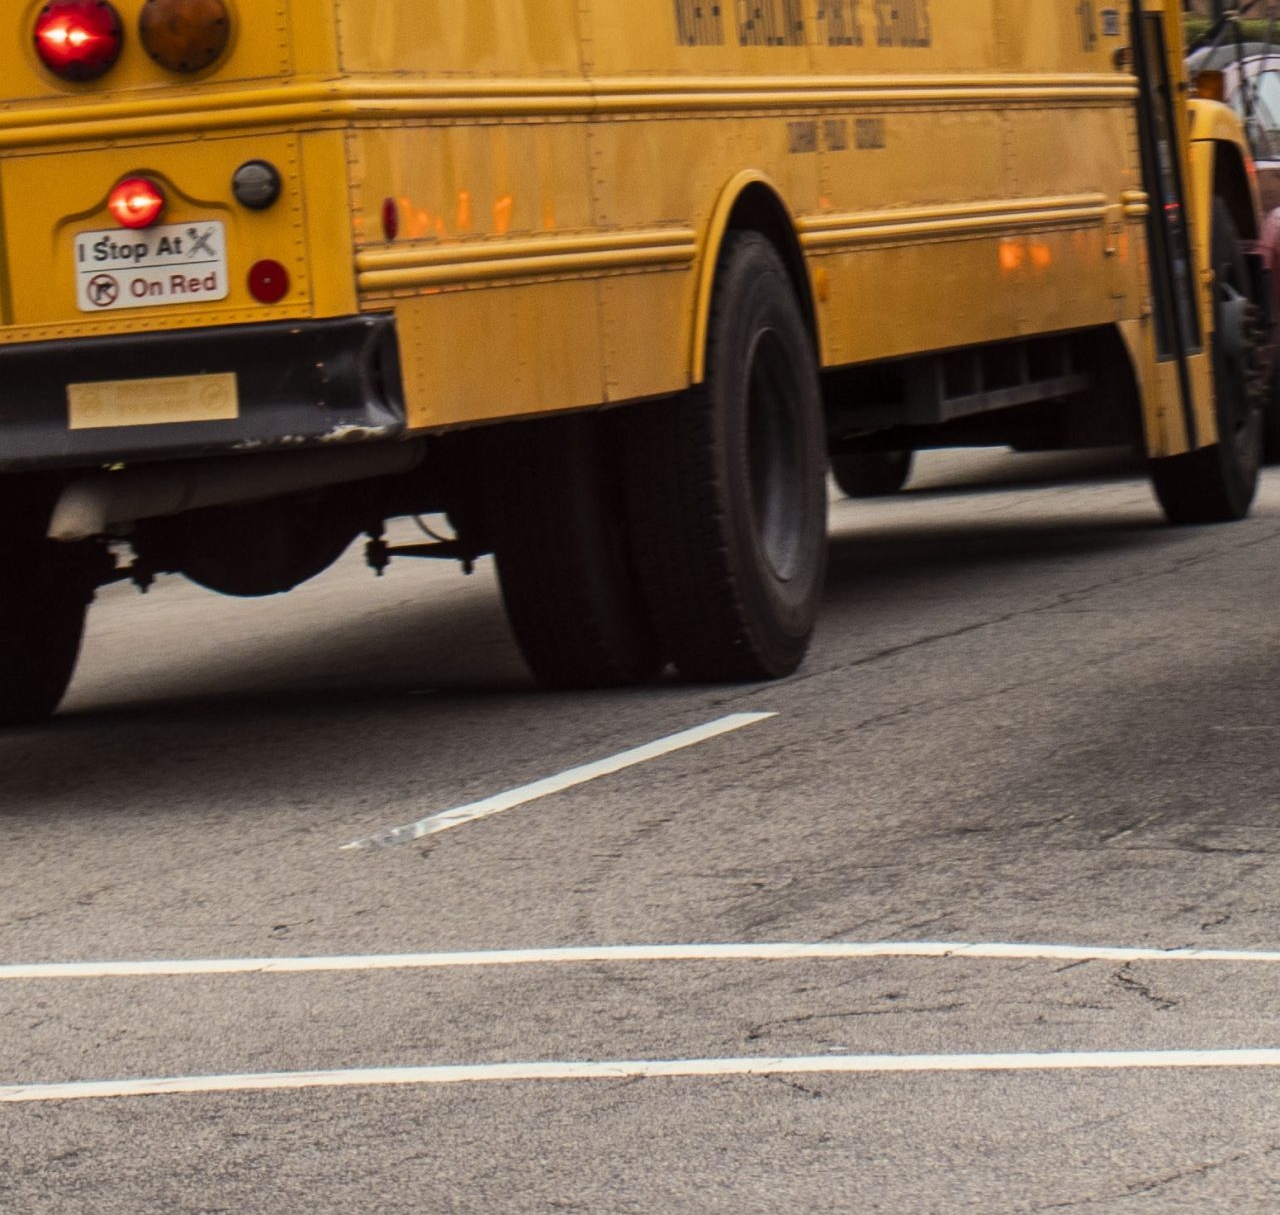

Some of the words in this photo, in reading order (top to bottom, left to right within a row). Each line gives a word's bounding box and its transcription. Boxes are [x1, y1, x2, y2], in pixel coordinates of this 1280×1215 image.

[78, 243, 86, 263] I
[93, 240, 148, 263] Stop
[156, 236, 183, 256] At
[130, 277, 163, 298] On
[171, 271, 217, 294] Red
